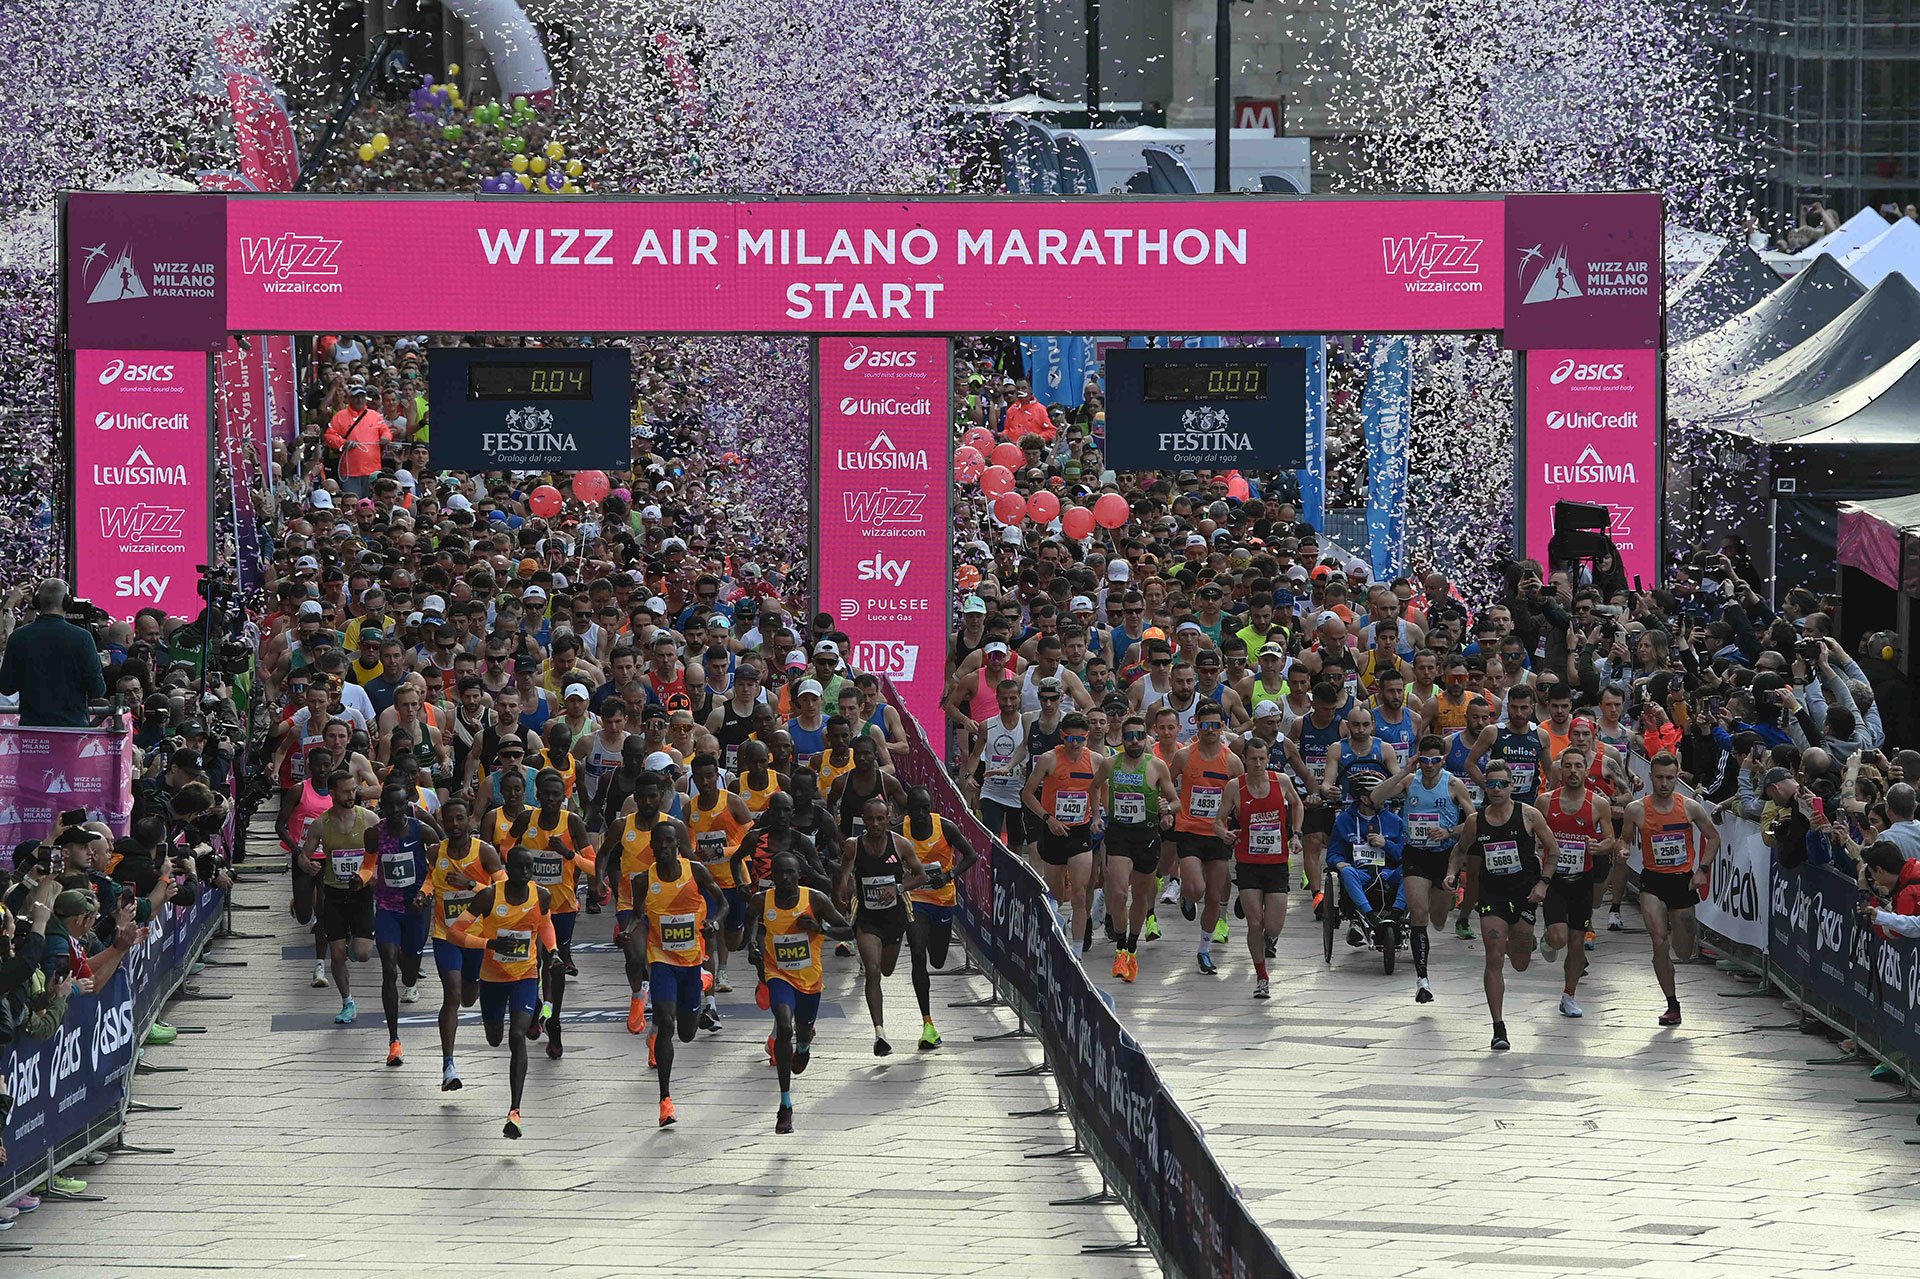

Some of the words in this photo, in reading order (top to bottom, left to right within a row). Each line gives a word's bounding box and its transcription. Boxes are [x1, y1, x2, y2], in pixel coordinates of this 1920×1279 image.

[478, 228, 614, 265] WIZZ
[631, 228, 718, 265] AIR
[737, 228, 938, 266] MILANO
[957, 228, 1247, 266] MARATHON
[153, 263, 189, 274] WIZZ
[191, 263, 215, 274] AIR
[1587, 262, 1622, 272] WIZZ
[1625, 262, 1649, 272] AIR
[153, 275, 215, 287] MILANO
[1587, 274, 1649, 285] MILANO
[263, 281, 342, 293] wizzair.com
[1404, 280, 1483, 292] wizzair.com
[1587, 286, 1649, 296] MARATHON
[153, 288, 215, 298] MARATHON
[785, 282, 944, 319] START
[860, 398, 931, 416] UniCredit
[116, 413, 190, 430] UniCredit
[1567, 411, 1638, 429] UniCredit
[481, 433, 578, 451] FESTINA
[1158, 433, 1253, 451] FESTINA
[497, 454, 527, 465] Orologi
[529, 454, 542, 463] dal
[838, 449, 928, 471] LEVISSIMA
[1173, 453, 1203, 464] Orologi
[1204, 453, 1218, 462] dal
[1219, 455, 1238, 463] 1902
[94, 464, 187, 486] LEVISSIMA
[1544, 462, 1636, 484] LEVISSIMA
[861, 527, 926, 537] wizzair.com
[119, 543, 186, 553] wizzair.com
[857, 551, 912, 587] sky
[115, 569, 171, 603] sky
[867, 599, 929, 610] PULSEE
[1062, 803, 1080, 813] 4420
[1197, 798, 1215, 808] 4839
[1256, 835, 1275, 845] 6259
[1660, 846, 1680, 856] 2586
[1492, 855, 1512, 866] 5689
[340, 862, 358, 872] 6918
[391, 865, 406, 877] 41
[664, 927, 692, 939] PM5
[777, 946, 807, 959] PM2
